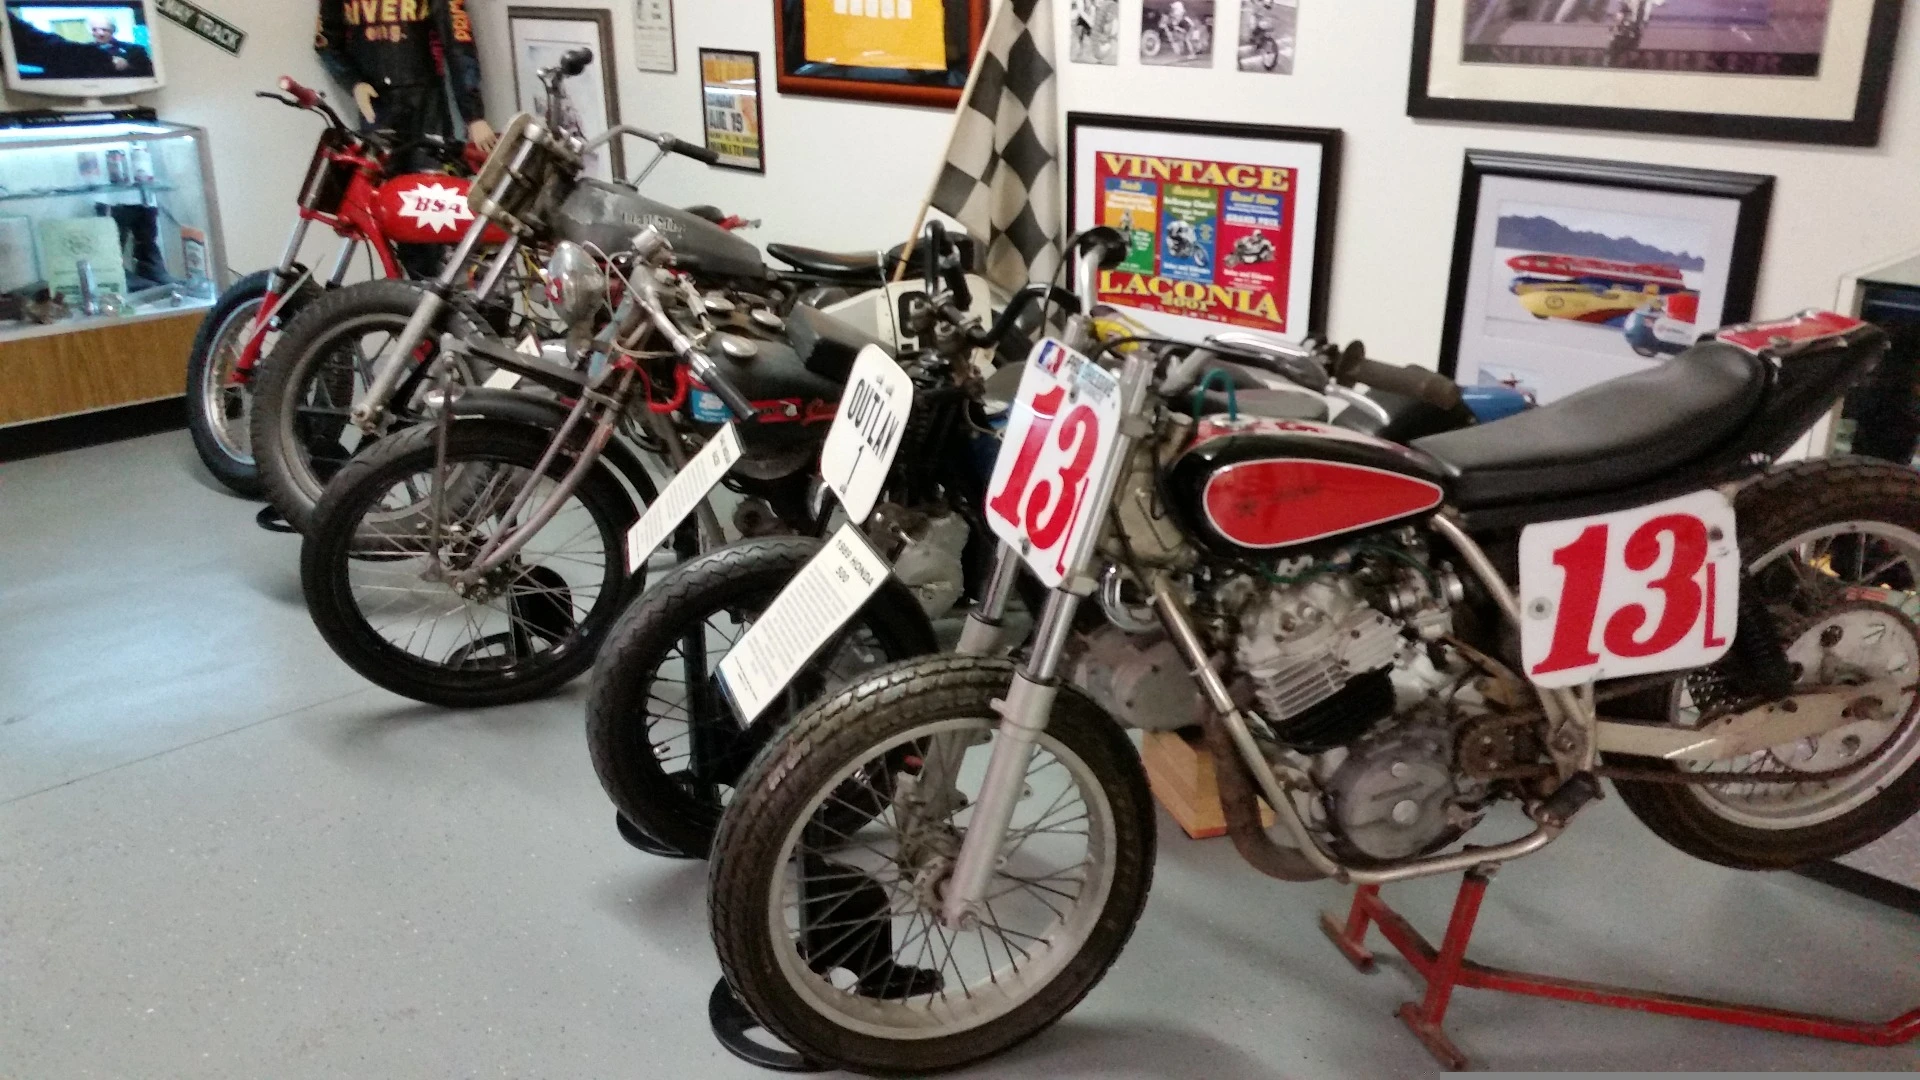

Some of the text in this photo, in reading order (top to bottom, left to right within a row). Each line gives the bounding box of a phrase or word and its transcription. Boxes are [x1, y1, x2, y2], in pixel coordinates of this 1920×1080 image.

[195, 13, 240, 50] TRACK
[730, 111, 744, 133] 19
[1101, 152, 1290, 192] VINTAGE
[415, 197, 461, 214] BSA
[1099, 269, 1284, 324] LACONIA
[1161, 294, 1211, 312] 2001
[847, 378, 899, 463] OUTLAW
[835, 565, 850, 583] 500
[850, 555, 874, 587] HONDA
